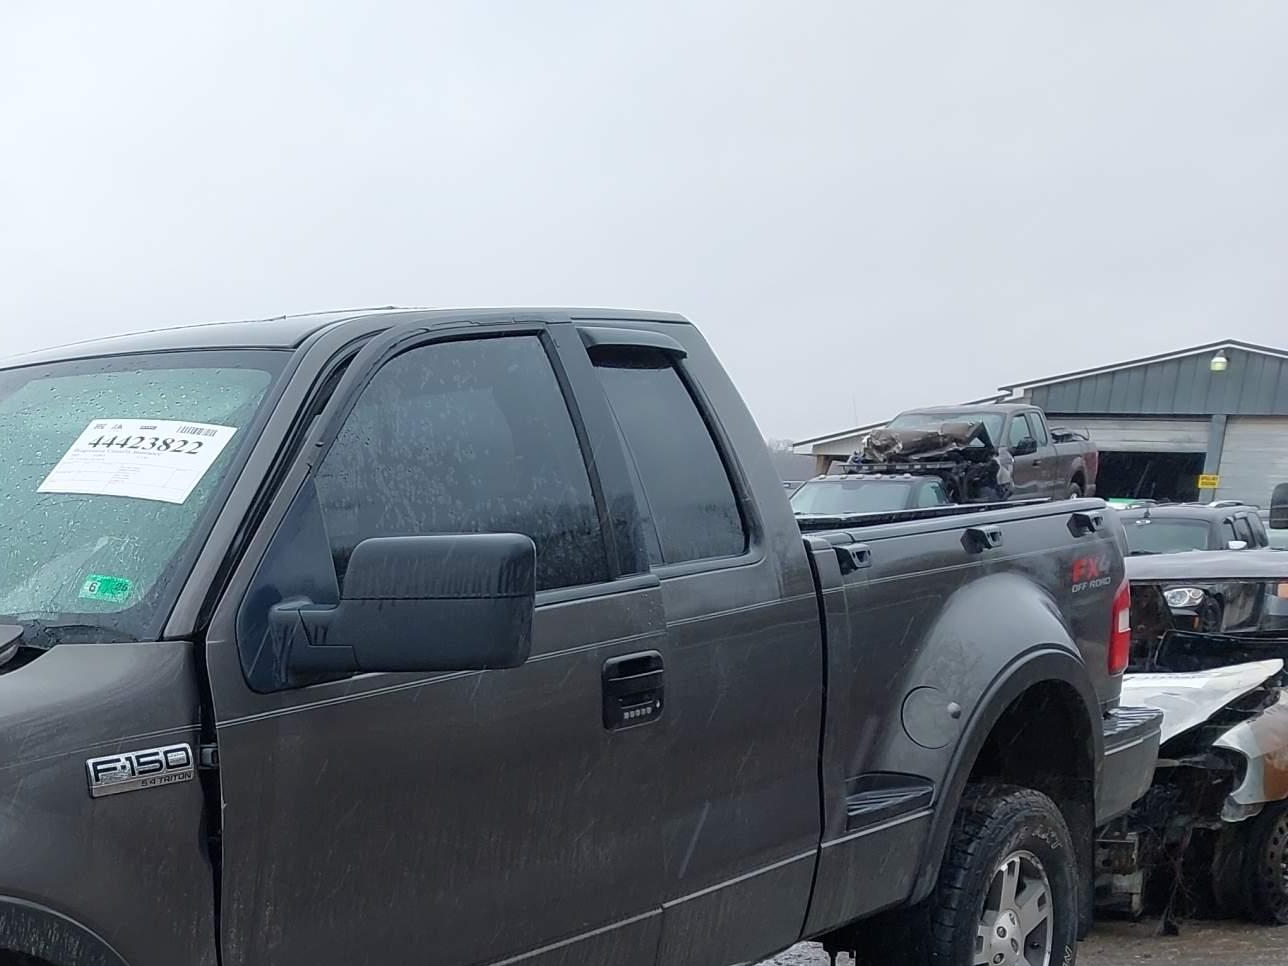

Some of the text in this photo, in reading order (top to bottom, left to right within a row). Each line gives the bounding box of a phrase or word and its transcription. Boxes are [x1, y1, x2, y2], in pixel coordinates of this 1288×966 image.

[88, 435, 204, 455] 44423822
[1072, 554, 1111, 583] FX4
[88, 582, 129, 593] 6 26
[1072, 576, 1111, 593] OFF ROAD
[92, 746, 191, 783] F-150
[158, 771, 192, 783] TRITON
